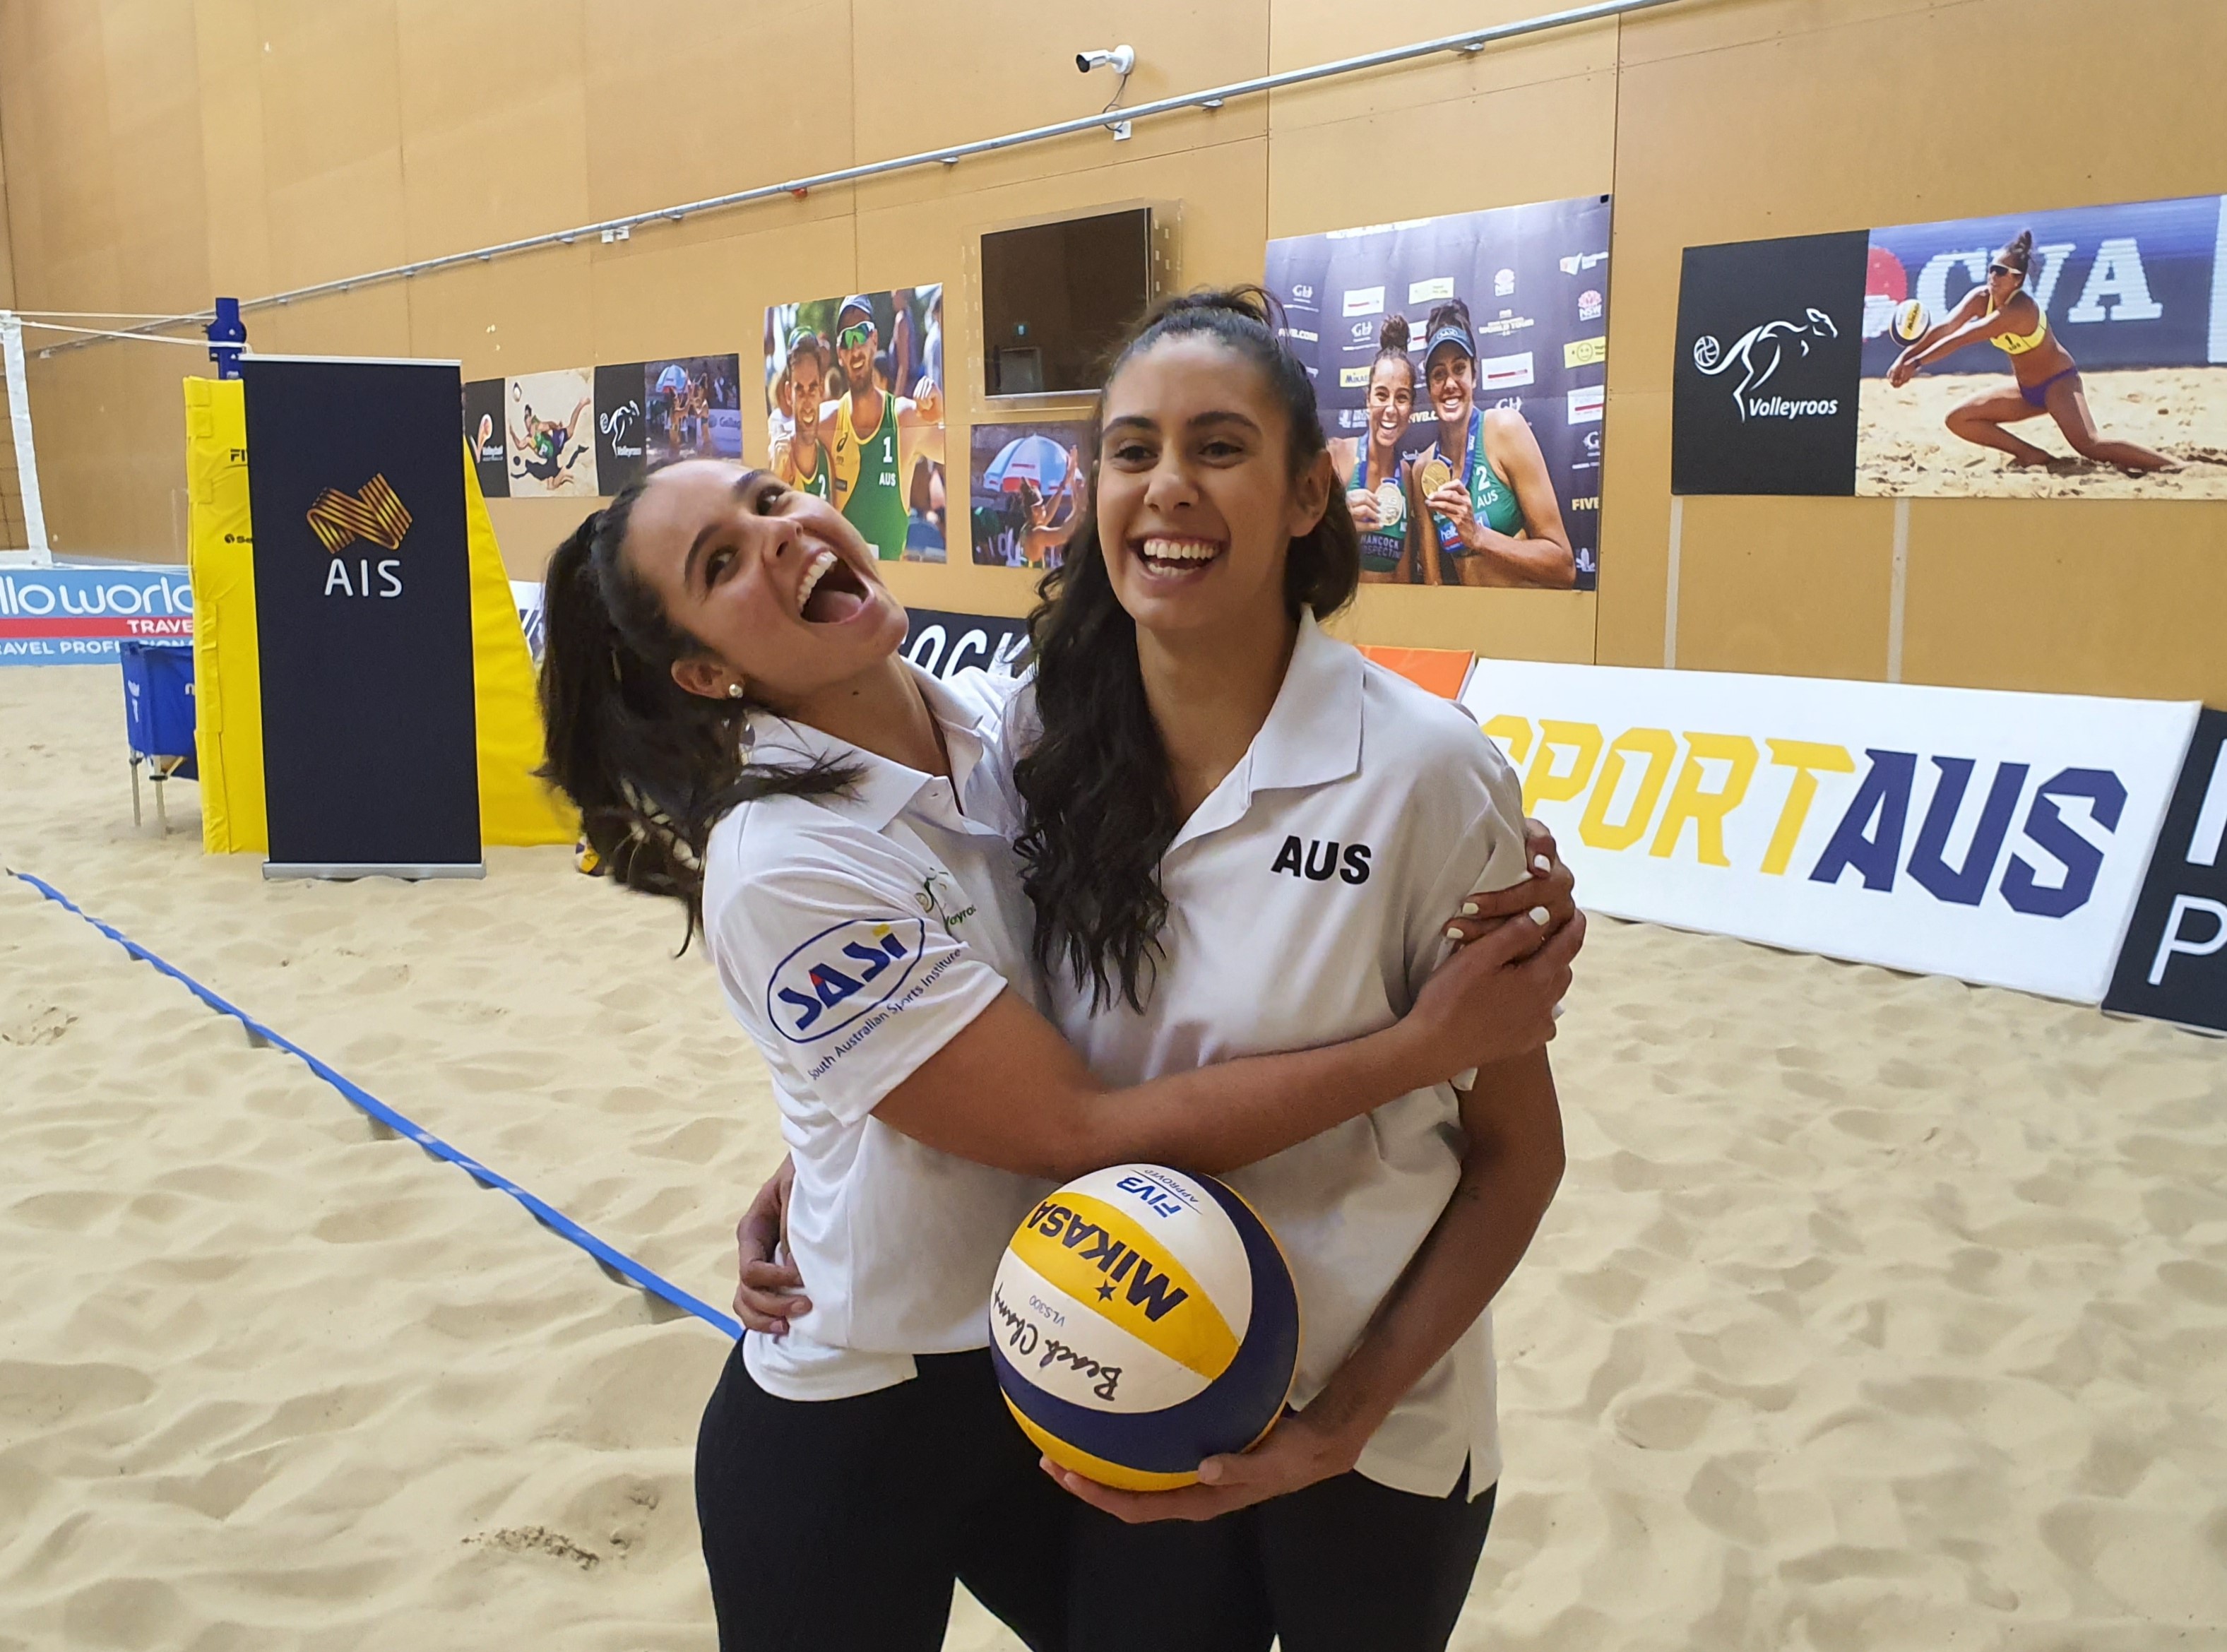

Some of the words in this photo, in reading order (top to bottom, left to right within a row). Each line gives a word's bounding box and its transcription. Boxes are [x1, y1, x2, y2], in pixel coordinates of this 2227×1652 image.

[1750, 396, 1839, 420] Volleyroos
[883, 436, 893, 463] 1
[879, 472, 897, 487] AUS
[1476, 466, 1492, 492] 2
[1477, 489, 1499, 509] AUS
[324, 558, 403, 598] AIS
[126, 619, 194, 634] TRAVE
[1271, 835, 1372, 885] AUS
[807, 1054, 837, 1081] South
[834, 1011, 890, 1058] Australian
[886, 982, 925, 1014] Sports
[920, 948, 962, 987] Institute
[1116, 1175, 1182, 1218] FIVB
[1144, 1168, 1199, 1203] APPROVED
[1028, 1294, 1066, 1328] VLS300
[1038, 1338, 1122, 1402] Beach
